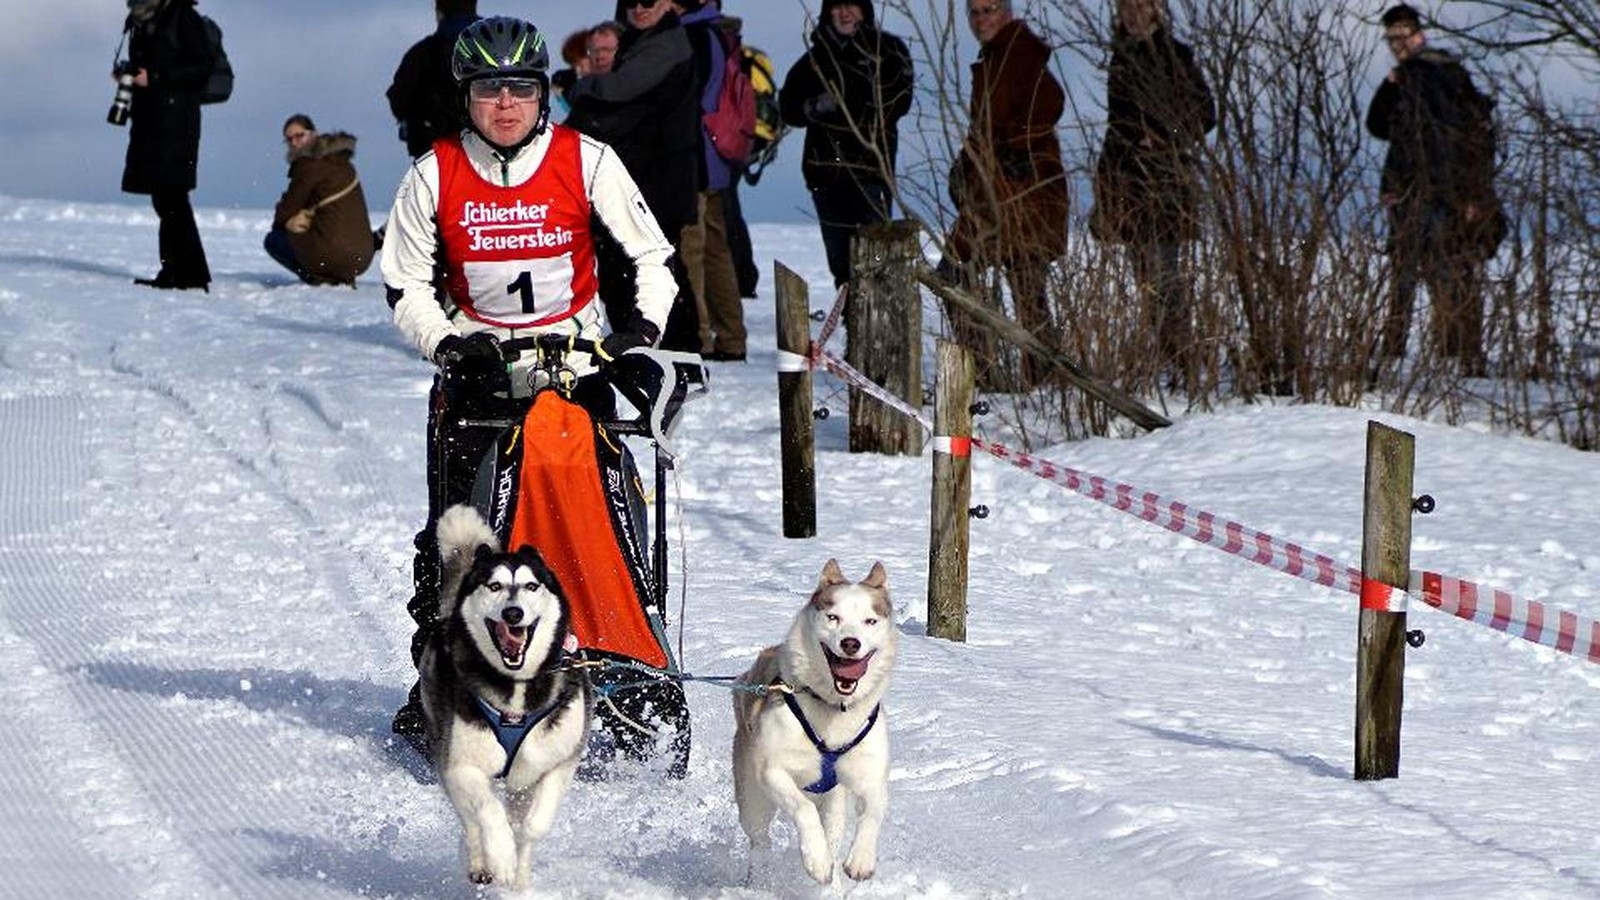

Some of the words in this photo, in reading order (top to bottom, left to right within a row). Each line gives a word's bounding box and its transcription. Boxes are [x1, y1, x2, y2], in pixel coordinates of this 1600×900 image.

[459, 199, 549, 227] Schierker
[467, 226, 573, 251] Feuerstein
[506, 271, 535, 314] 1
